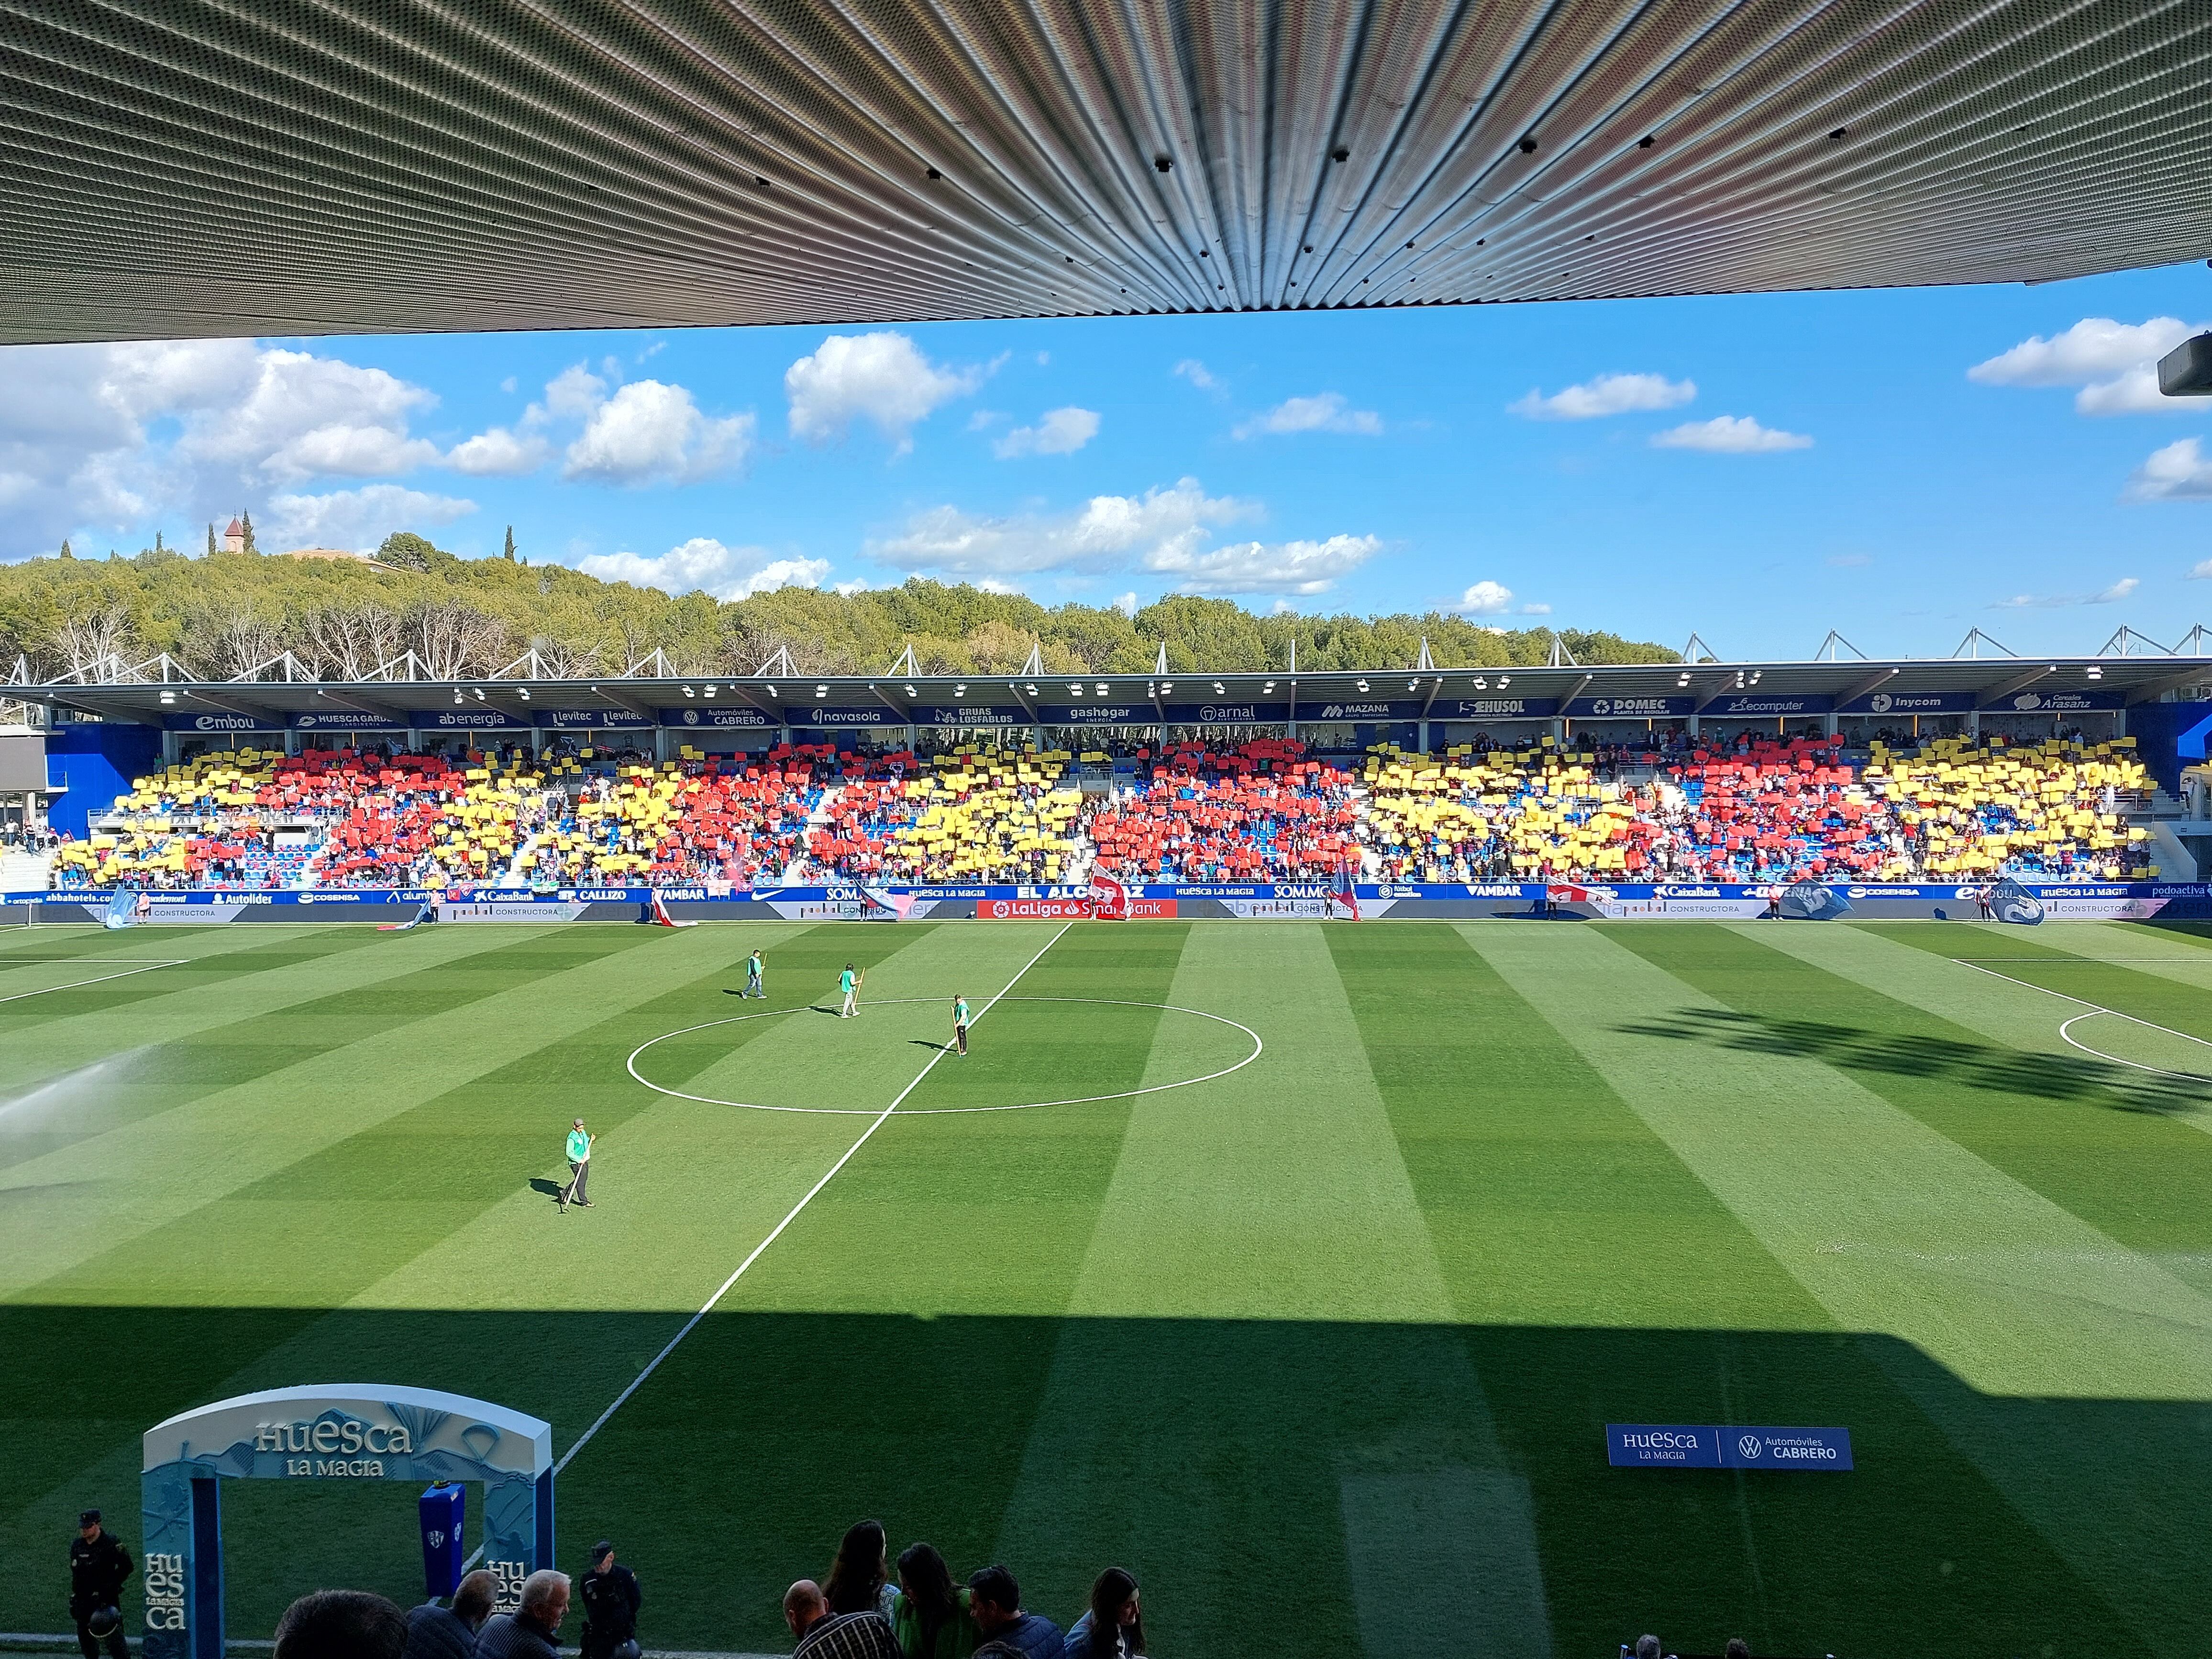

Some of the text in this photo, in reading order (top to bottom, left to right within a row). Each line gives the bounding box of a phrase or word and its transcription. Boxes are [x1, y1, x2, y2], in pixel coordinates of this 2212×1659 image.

[1614, 699, 1666, 710] DOMEC
[1747, 701, 1804, 712] ecomputer
[1896, 697, 1941, 707] Inycom
[2041, 699, 2091, 709] Arasanz
[1218, 705, 1255, 718] arnal
[1345, 705, 1389, 713] MAZANA
[559, 711, 592, 720] levitec
[714, 716, 765, 725] CABRERO
[824, 711, 880, 722] navasola
[196, 714, 254, 730] embou
[579, 891, 627, 900] CALLIZO
[664, 889, 706, 900] AMBAR
[1017, 886, 1042, 899] EL
[1274, 885, 1329, 898] SOMMO
[1477, 885, 1523, 896] AMBAR
[1668, 886, 1720, 897] CaixaBank
[487, 891, 534, 902] CaixaBank
[1012, 902, 1061, 917] LaLiga
[1623, 1433, 1698, 1449] Huesca
[1765, 1437, 1823, 1447] Automóviles
[1773, 1447, 1837, 1459] CABRERO
